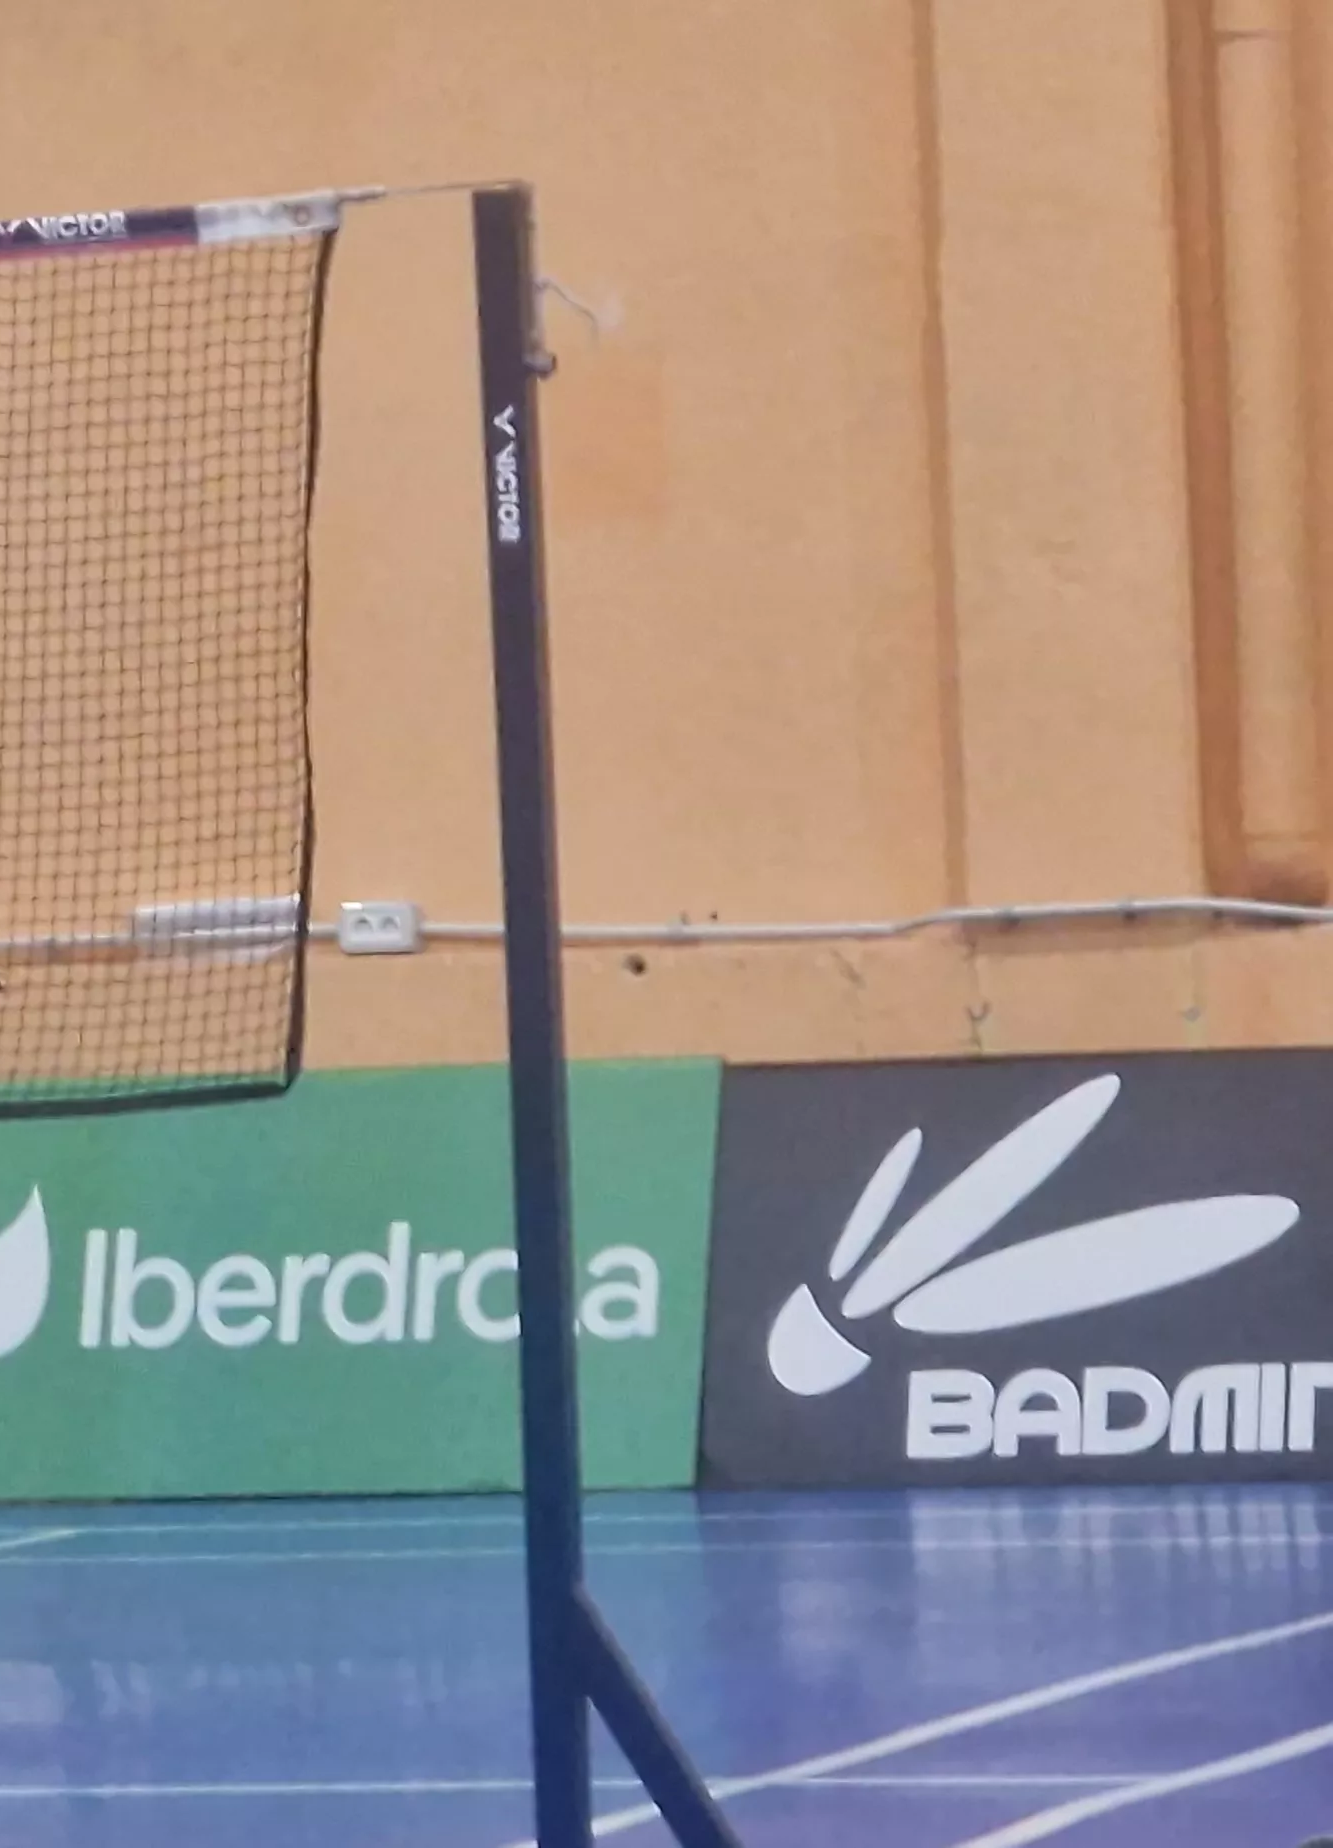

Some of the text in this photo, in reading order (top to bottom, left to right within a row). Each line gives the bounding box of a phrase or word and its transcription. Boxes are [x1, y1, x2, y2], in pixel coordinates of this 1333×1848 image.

[26, 210, 128, 241] VICTOR
[495, 441, 521, 543] VICTOR
[80, 1221, 658, 1350] Iberdroa
